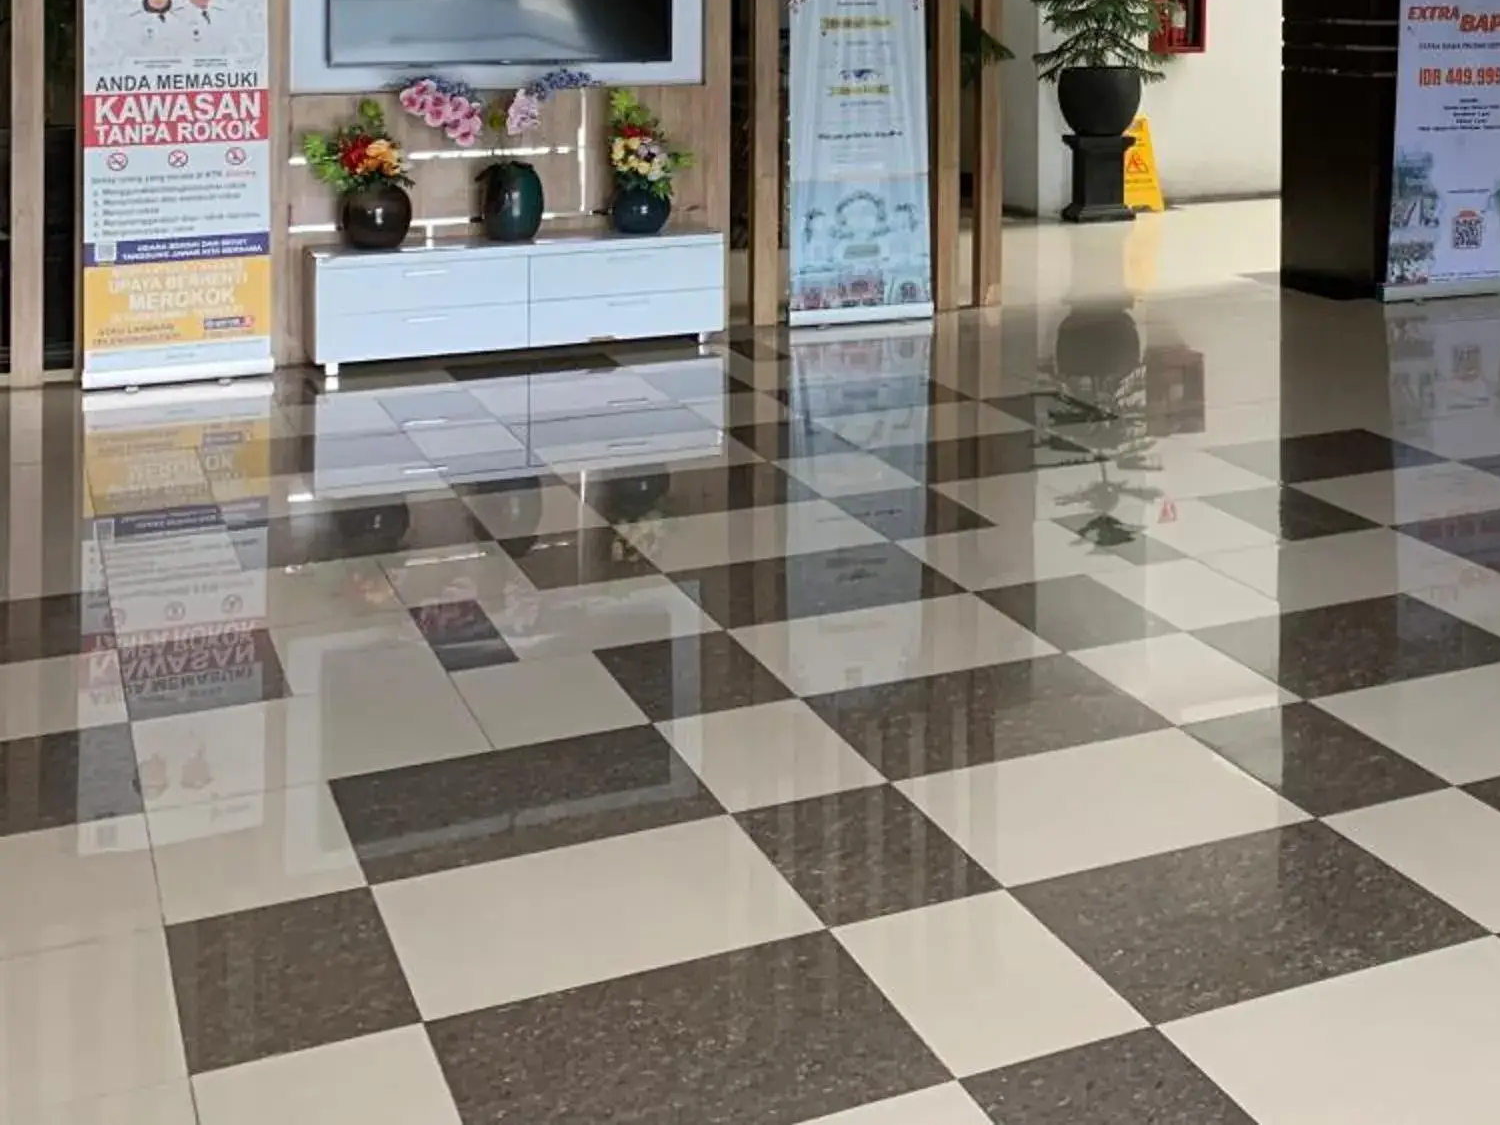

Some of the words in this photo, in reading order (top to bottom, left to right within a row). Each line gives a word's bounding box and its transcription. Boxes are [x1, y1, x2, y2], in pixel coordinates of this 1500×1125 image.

[1407, 5, 1460, 22] EXTRA
[95, 75, 151, 92] ANDA
[156, 72, 258, 89] MEMASUKI
[1418, 67, 1442, 88] IDR
[94, 91, 261, 124] KAWASAN
[94, 122, 173, 145] TANPA
[177, 119, 260, 142] ROKOK
[128, 288, 237, 311] MEROKOK
